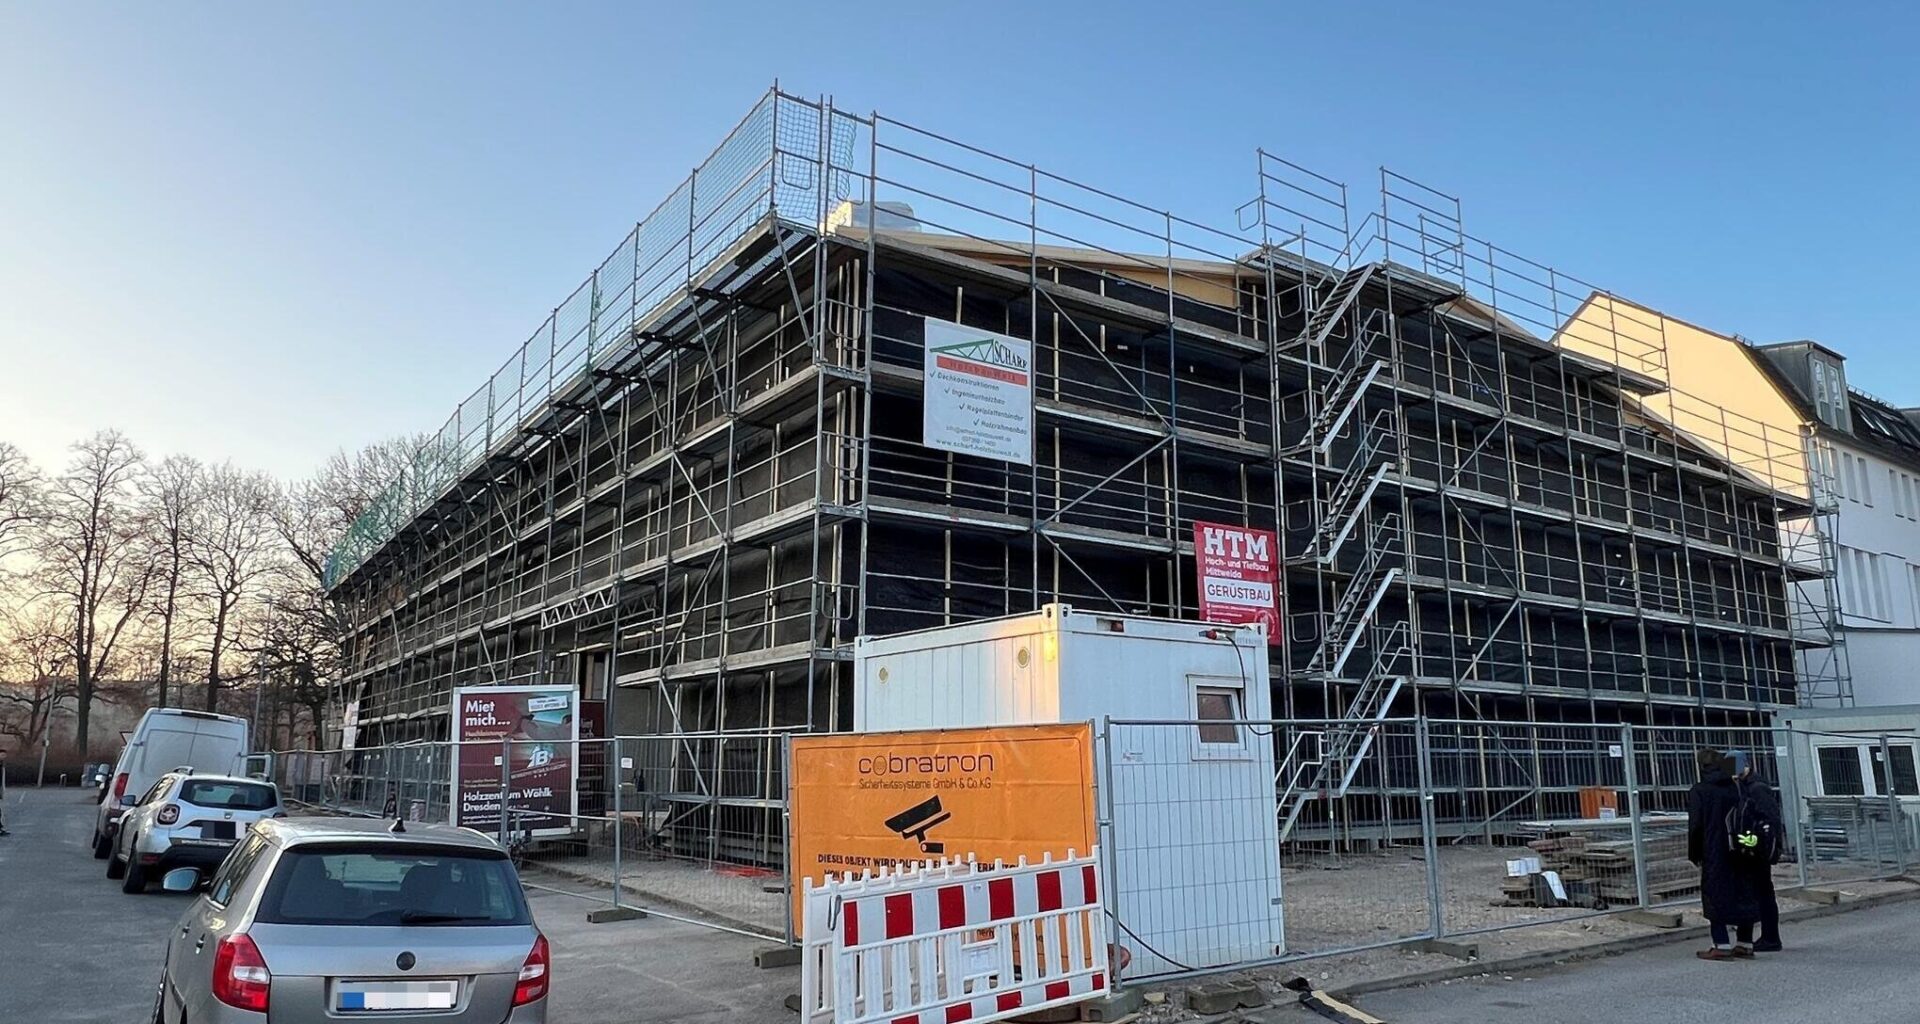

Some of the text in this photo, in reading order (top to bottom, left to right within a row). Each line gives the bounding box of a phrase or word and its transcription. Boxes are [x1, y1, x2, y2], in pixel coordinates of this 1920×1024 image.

[937, 371, 1000, 391] Dachkonstruktionen
[1203, 527, 1269, 561] HTM
[1205, 556, 1270, 572] Hoch- und Tiefbau
[1206, 566, 1242, 578] Mittweida
[1207, 583, 1271, 601] GERÜSTBAU
[465, 700, 495, 713] Miet
[858, 752, 994, 776] cobratron
[933, 777, 957, 789] GmbH
[959, 777, 965, 788] &
[463, 786, 552, 802] Holzzentum Wöhlk
[463, 801, 501, 812] Dresden
[818, 854, 843, 864] DIESES
[844, 856, 871, 867] OBJEKT
[873, 859, 896, 868] WIRD
